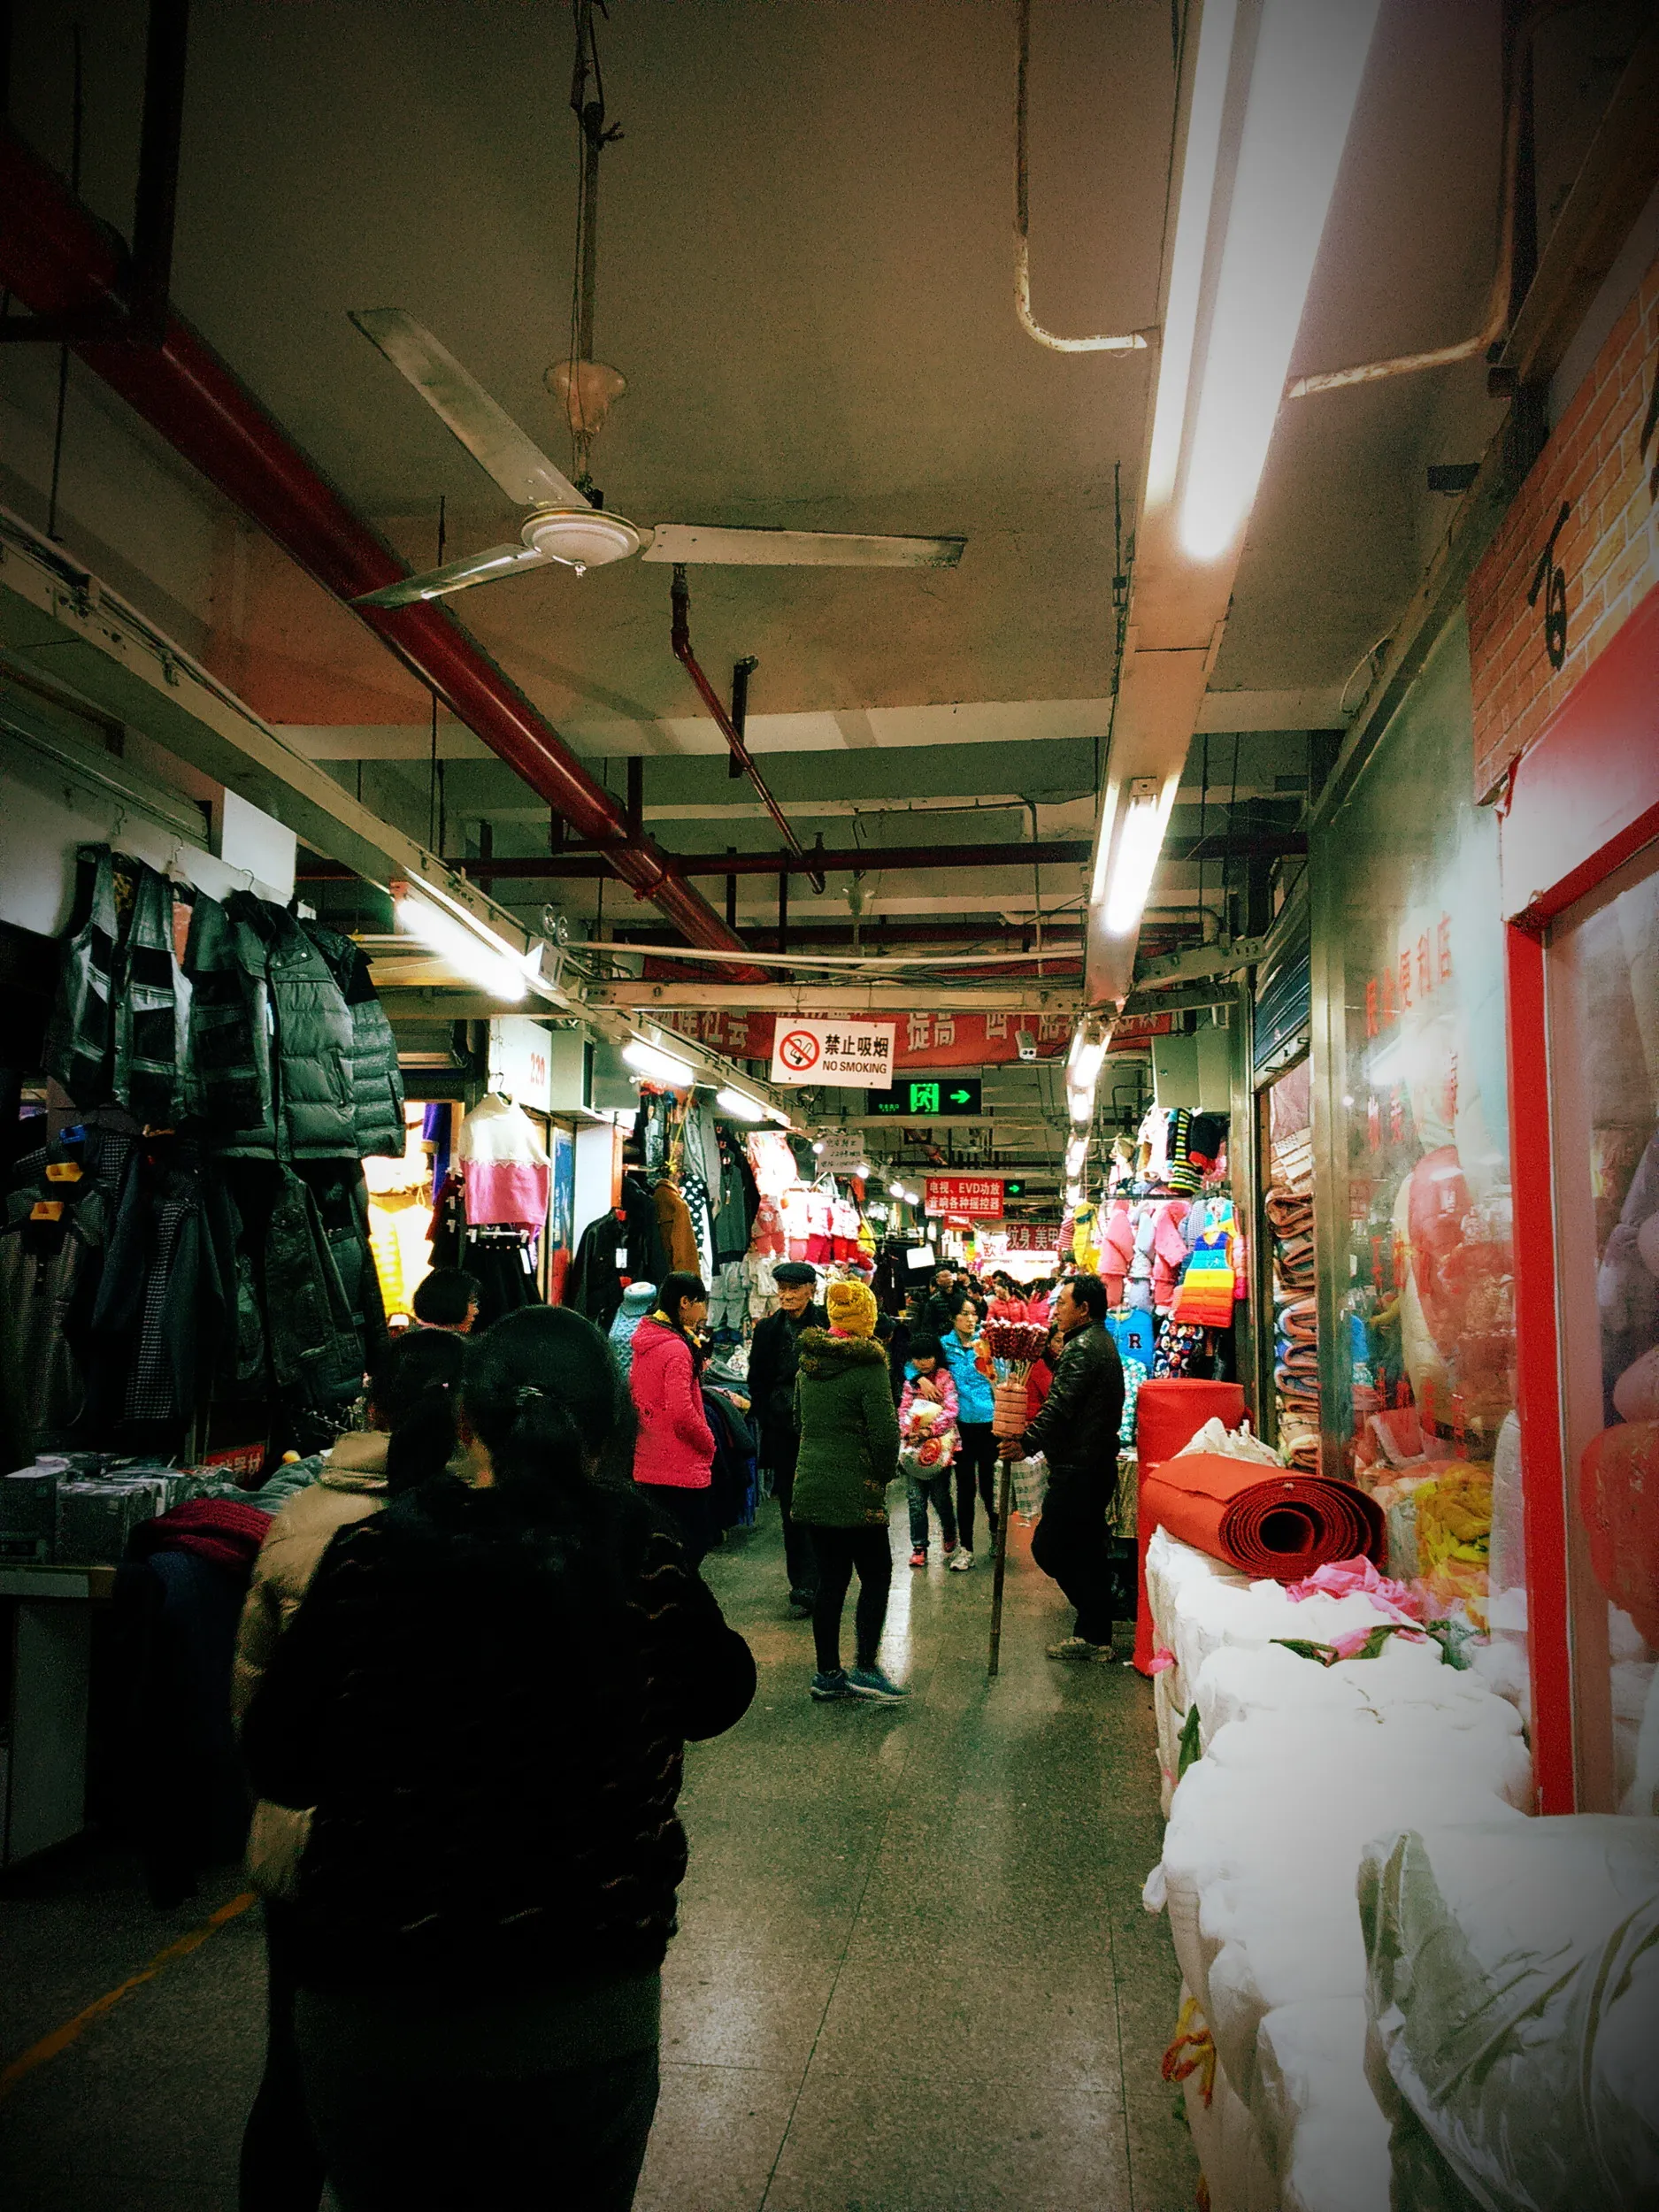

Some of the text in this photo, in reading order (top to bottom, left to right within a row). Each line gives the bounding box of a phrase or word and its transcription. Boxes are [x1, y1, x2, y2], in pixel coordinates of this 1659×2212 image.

[825, 1033, 889, 1057] 禁止吸烟
[822, 1060, 887, 1073] NO SMOKING
[1128, 1333, 1142, 1349] R
